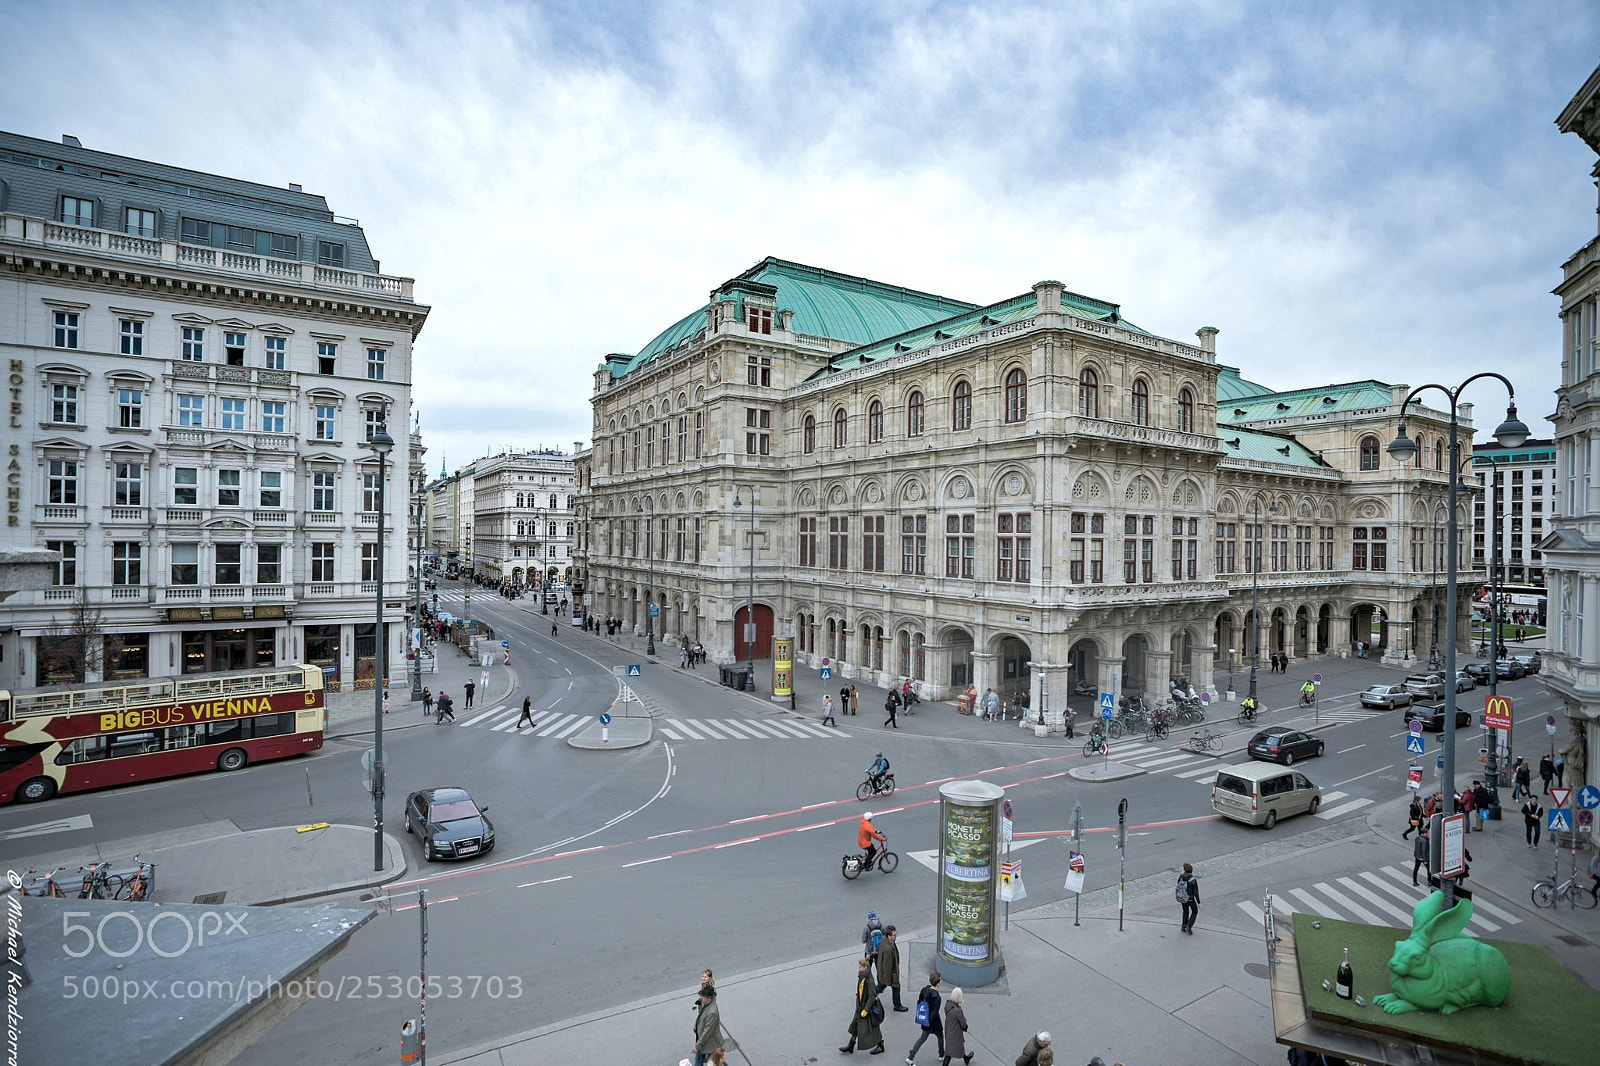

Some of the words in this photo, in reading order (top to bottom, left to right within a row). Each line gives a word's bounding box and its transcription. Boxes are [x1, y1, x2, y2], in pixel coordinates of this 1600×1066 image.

[9, 359, 23, 428] HOTEL
[7, 444, 20, 527] SACHER
[100, 705, 184, 731] BIGBUS
[191, 697, 272, 720] VIENNA
[947, 821, 975, 834] MONET
[947, 828, 981, 841] PICASSO
[946, 864, 989, 877] ALBERTINA
[945, 898, 972, 912] MONET
[945, 905, 979, 920] PICASSO
[944, 940, 987, 955] ALBERTINA
